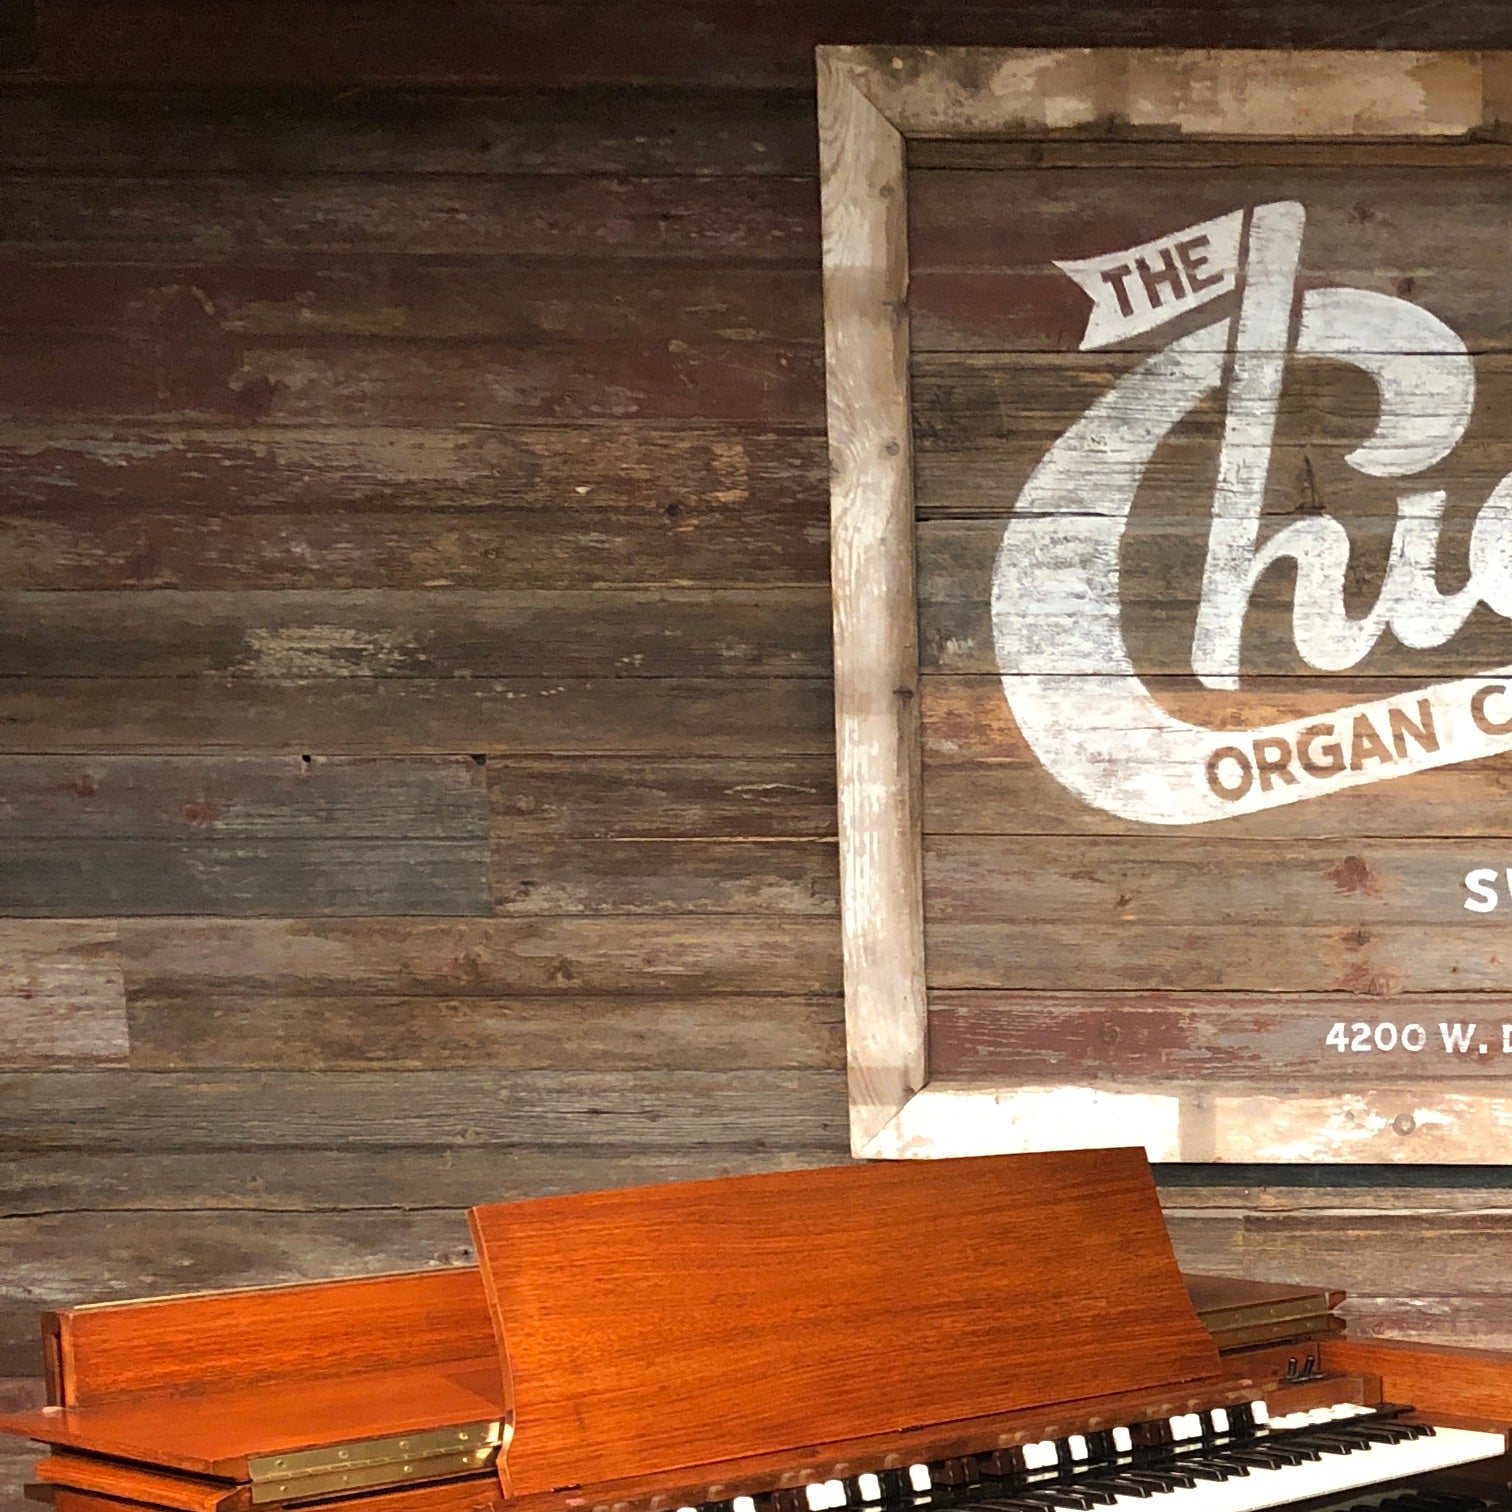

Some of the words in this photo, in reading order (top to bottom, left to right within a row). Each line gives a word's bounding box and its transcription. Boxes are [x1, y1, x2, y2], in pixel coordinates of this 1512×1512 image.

[1101, 234, 1224, 318] THE
[1206, 700, 1440, 801] ORGAN
[1325, 1022, 1426, 1053] 4200
[1438, 1022, 1488, 1054] W.
